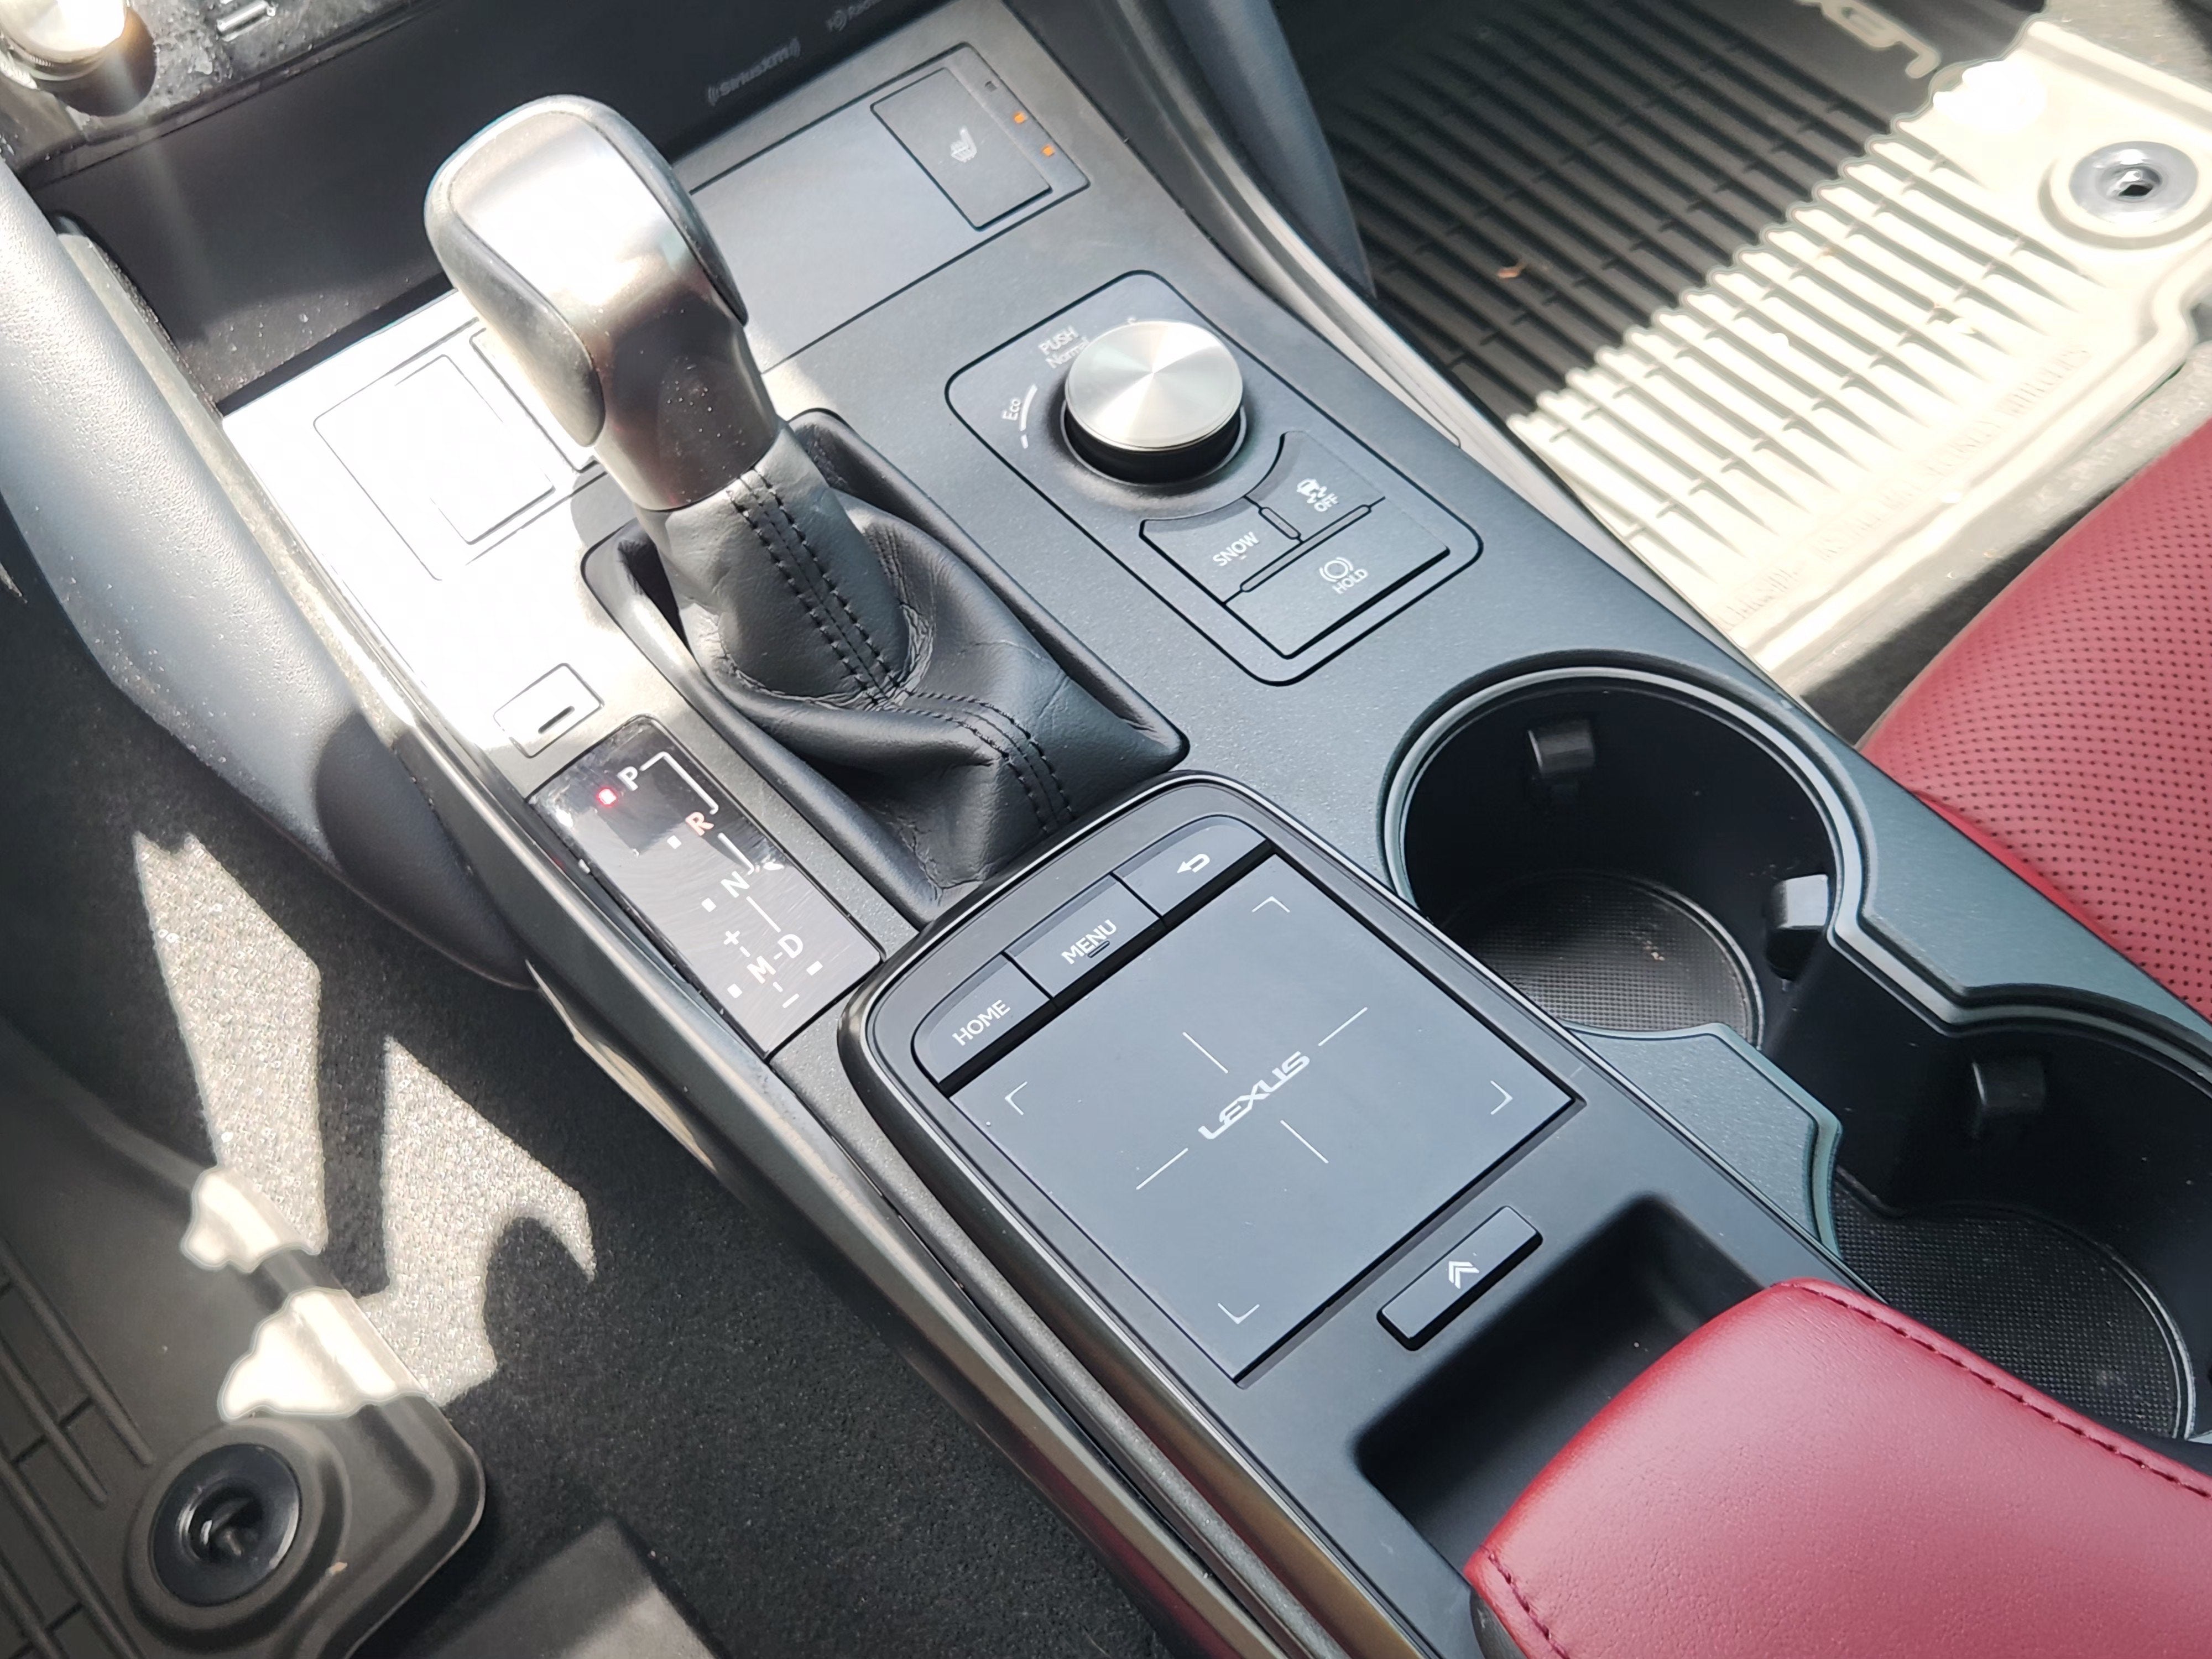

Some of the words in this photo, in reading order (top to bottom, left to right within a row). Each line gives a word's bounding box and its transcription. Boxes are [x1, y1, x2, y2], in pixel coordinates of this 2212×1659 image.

[1039, 326, 1079, 356] PUSH
[1002, 398, 1021, 421] Eco
[1314, 493, 1339, 512] OFF
[1213, 531, 1259, 566] SNOW
[1333, 568, 1369, 594] HOLD
[618, 766, 638, 790] P
[686, 812, 714, 836] R
[721, 872, 750, 898] N
[1061, 920, 1117, 964] MENU
[952, 999, 1011, 1046] HOME
[1198, 1051, 1310, 1140] LEXUS
